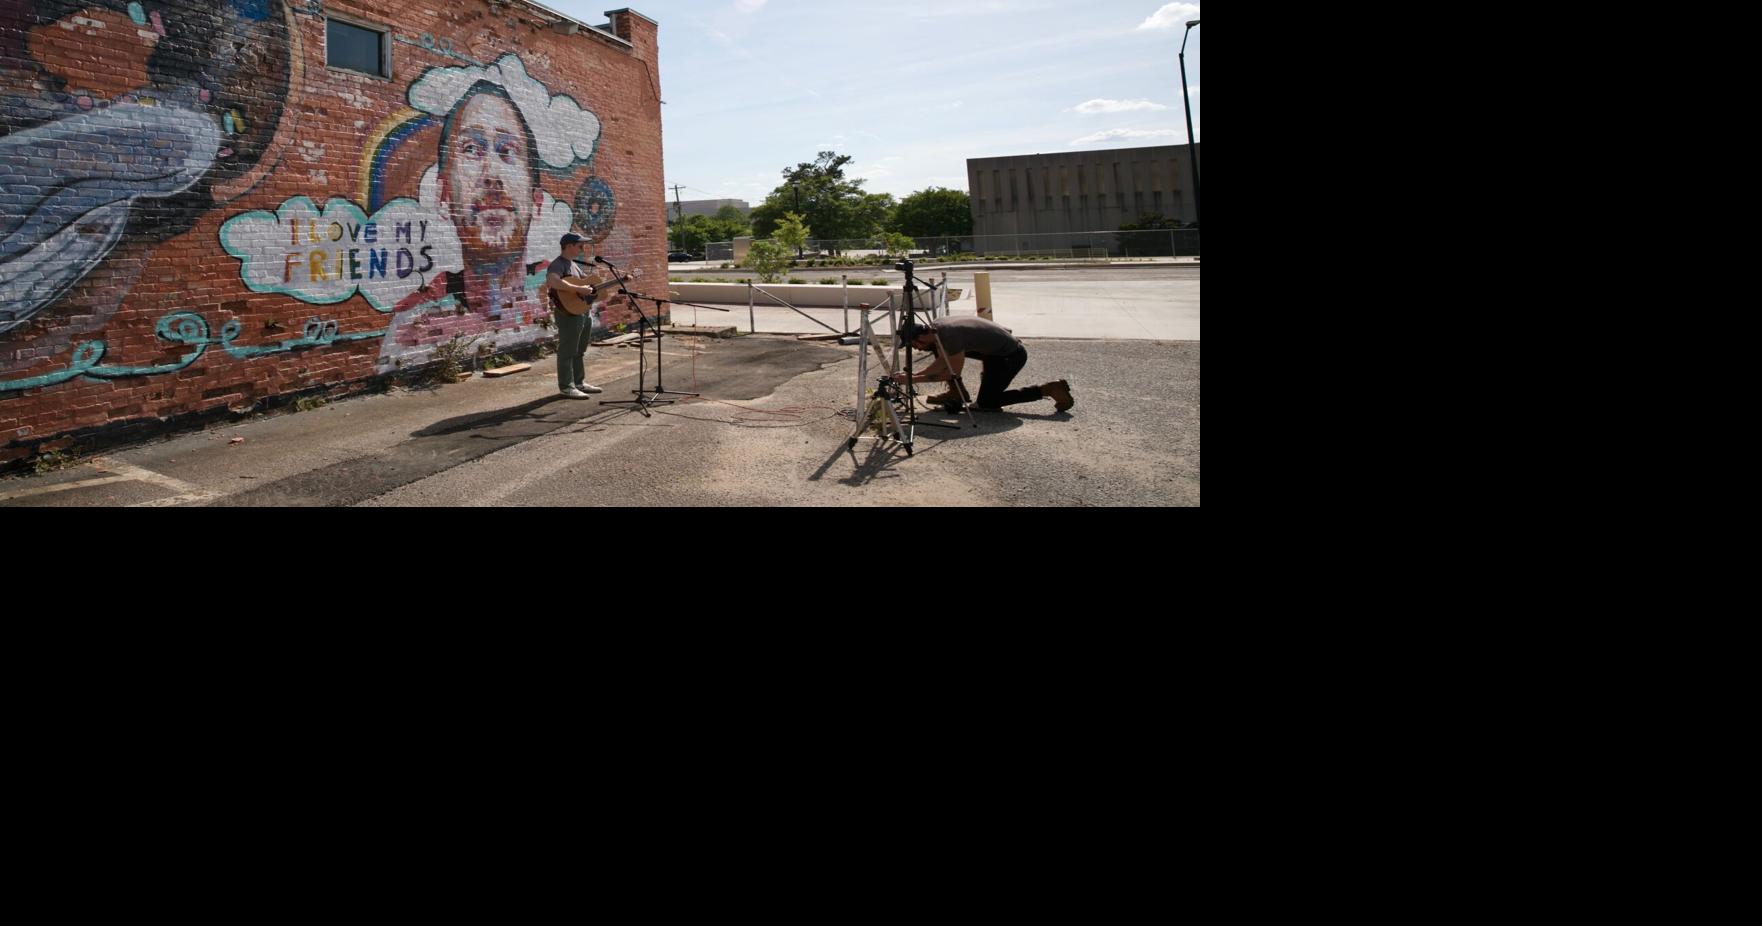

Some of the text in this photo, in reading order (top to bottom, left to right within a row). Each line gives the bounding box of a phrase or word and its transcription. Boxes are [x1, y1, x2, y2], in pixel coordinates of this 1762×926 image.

[291, 218, 428, 245] I LOVE MY
[284, 245, 434, 283] FRIENDS
